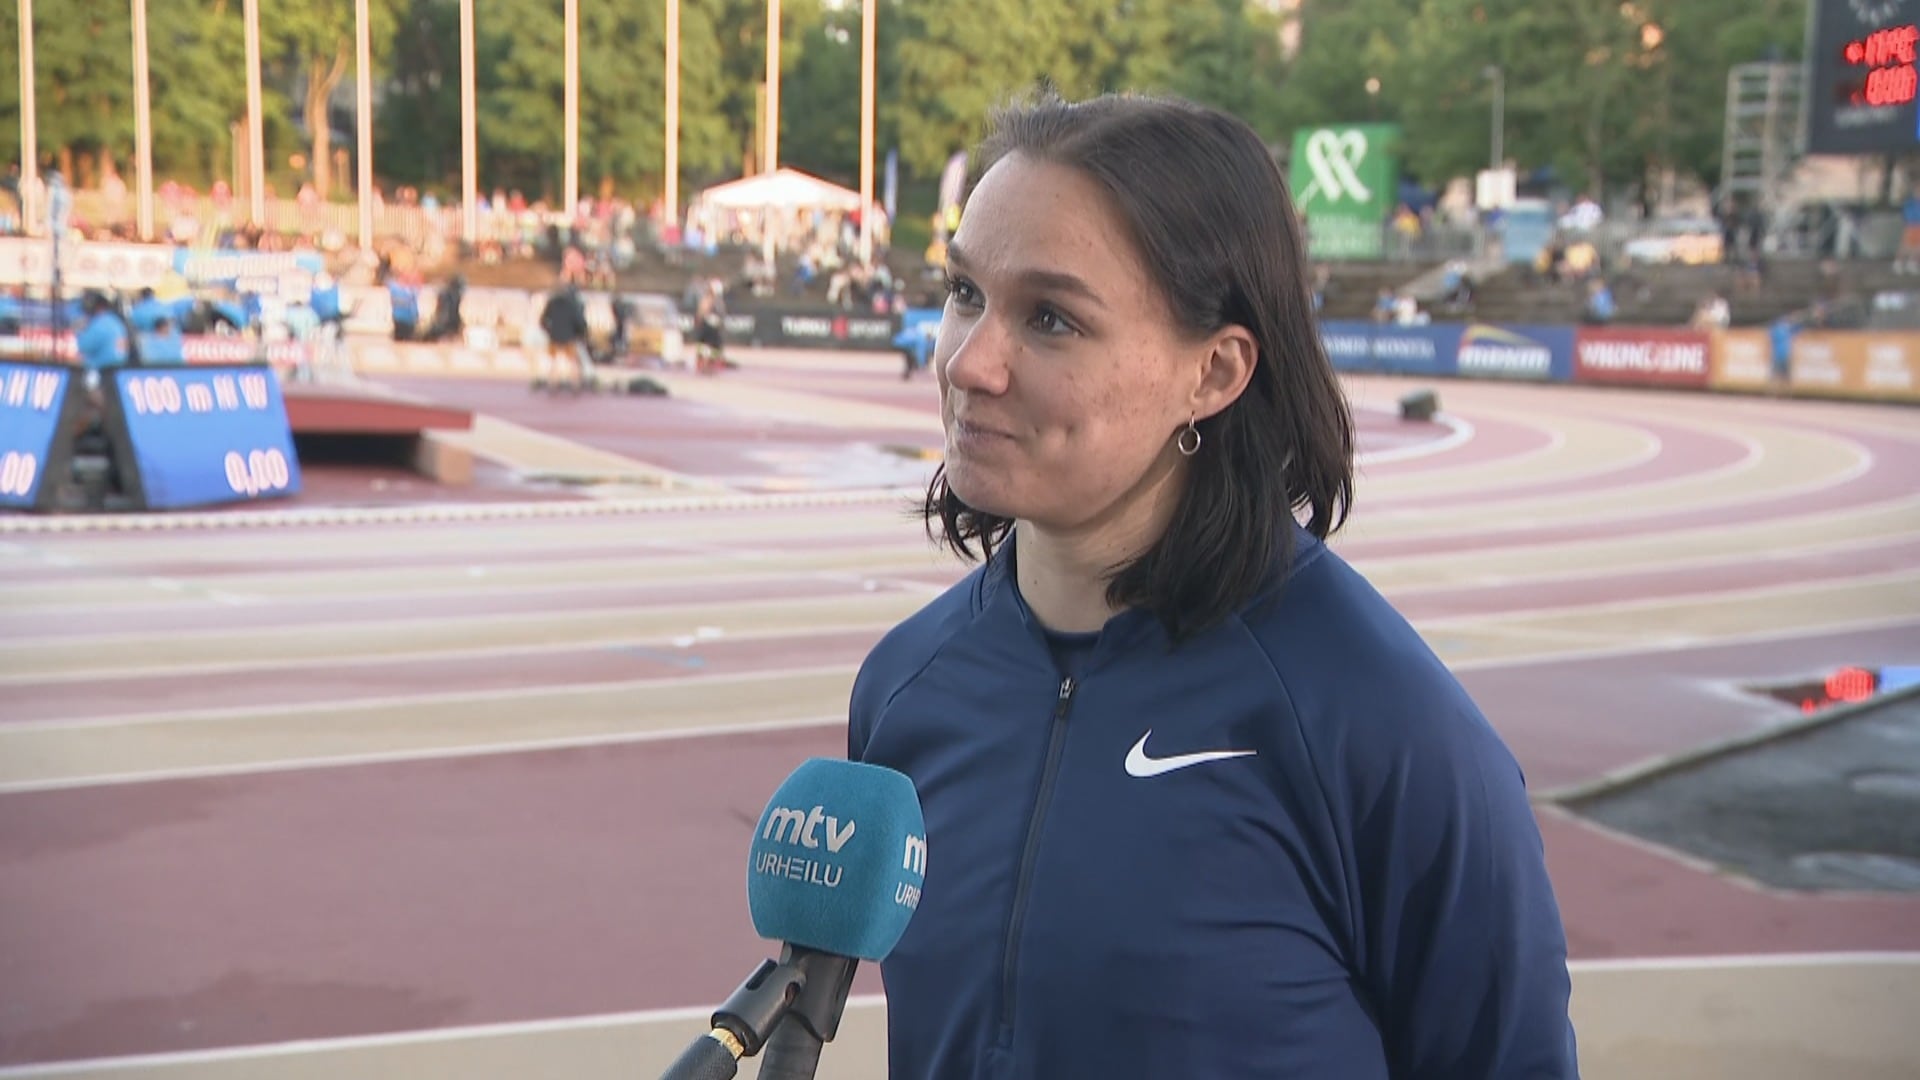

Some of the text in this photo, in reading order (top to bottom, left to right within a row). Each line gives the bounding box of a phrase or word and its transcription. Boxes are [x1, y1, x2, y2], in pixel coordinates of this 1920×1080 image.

[128, 376, 181, 414] 100
[185, 383, 213, 412] m
[239, 373, 268, 410] W
[763, 805, 855, 853] mtv
[755, 851, 843, 887] URHEILU
